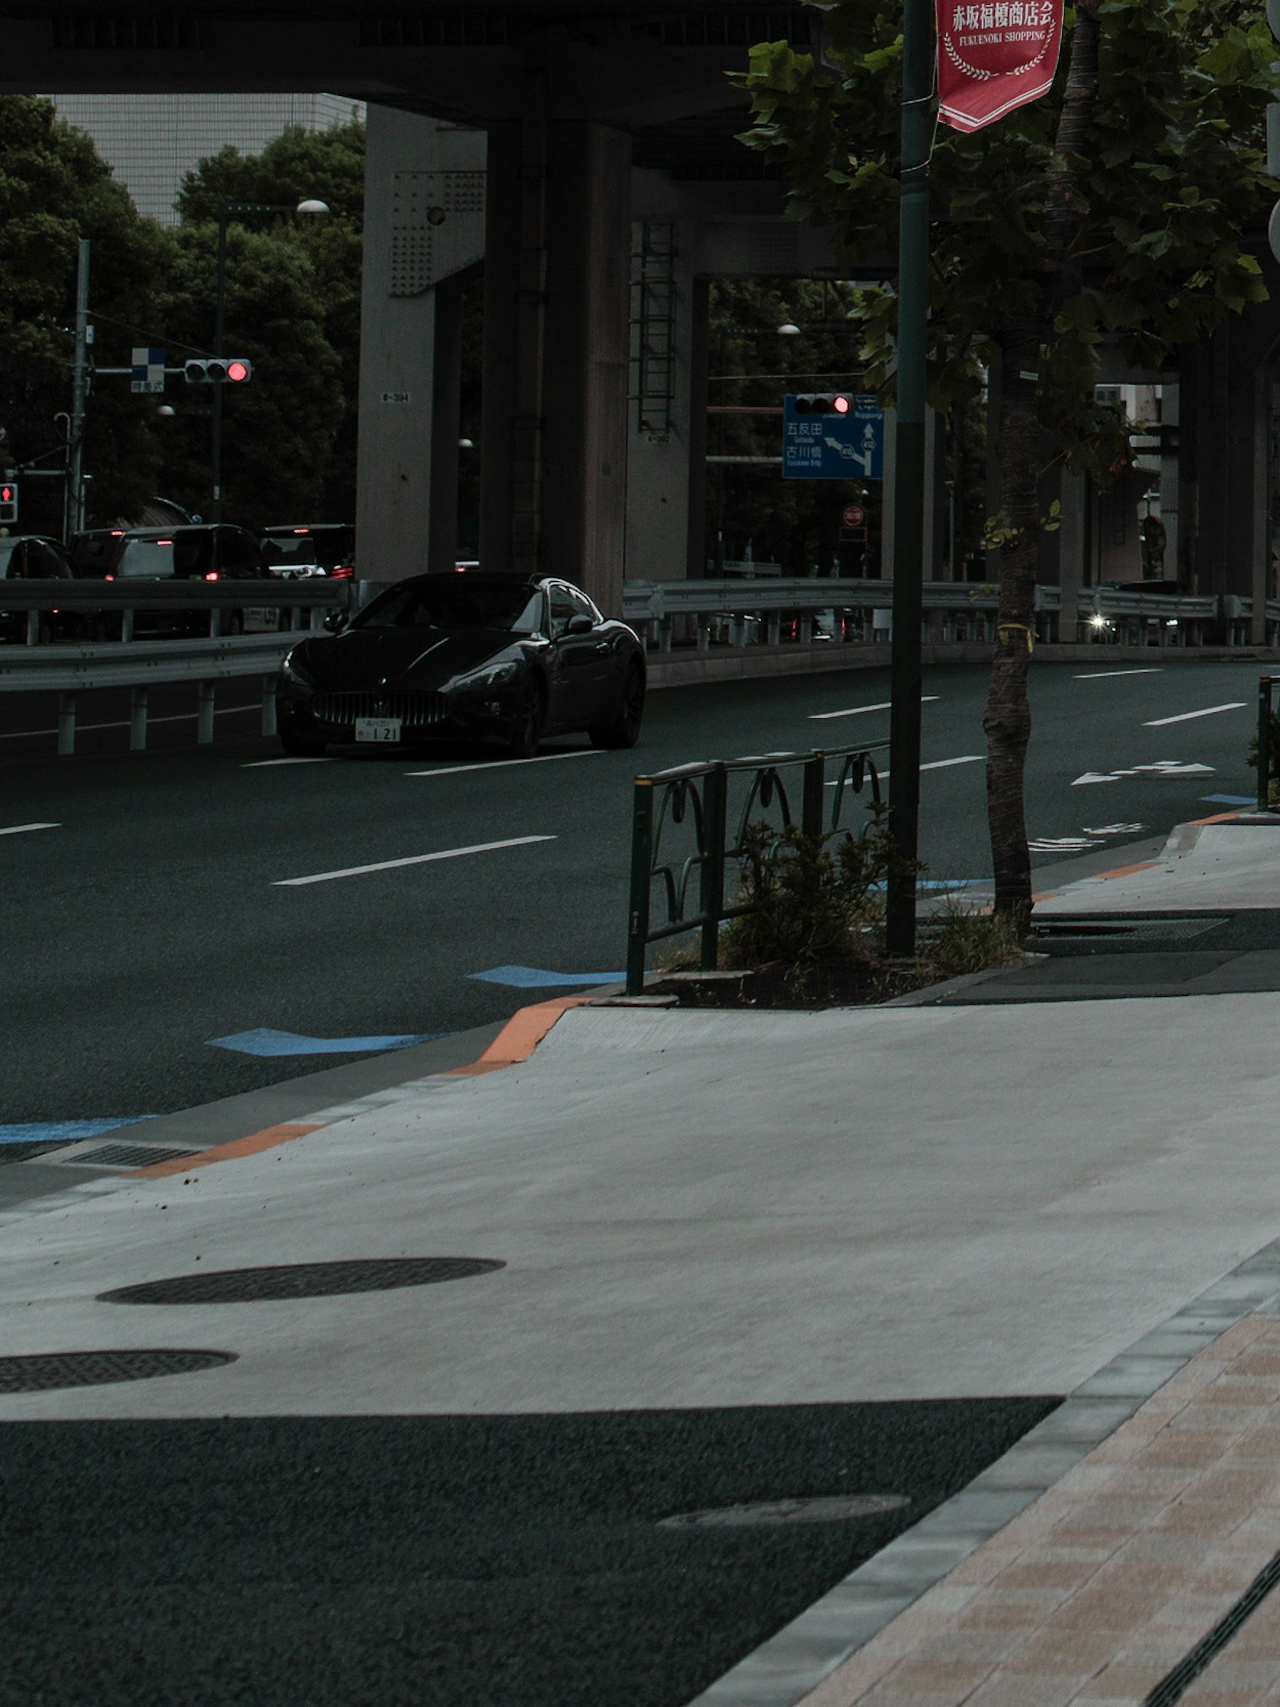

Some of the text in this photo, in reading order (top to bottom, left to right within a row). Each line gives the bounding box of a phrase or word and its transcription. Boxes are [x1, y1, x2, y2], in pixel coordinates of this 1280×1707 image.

[953, 1, 1054, 32] 赤坂福榎商店会
[960, 31, 1046, 46] FUKUENOKI SHOPPING
